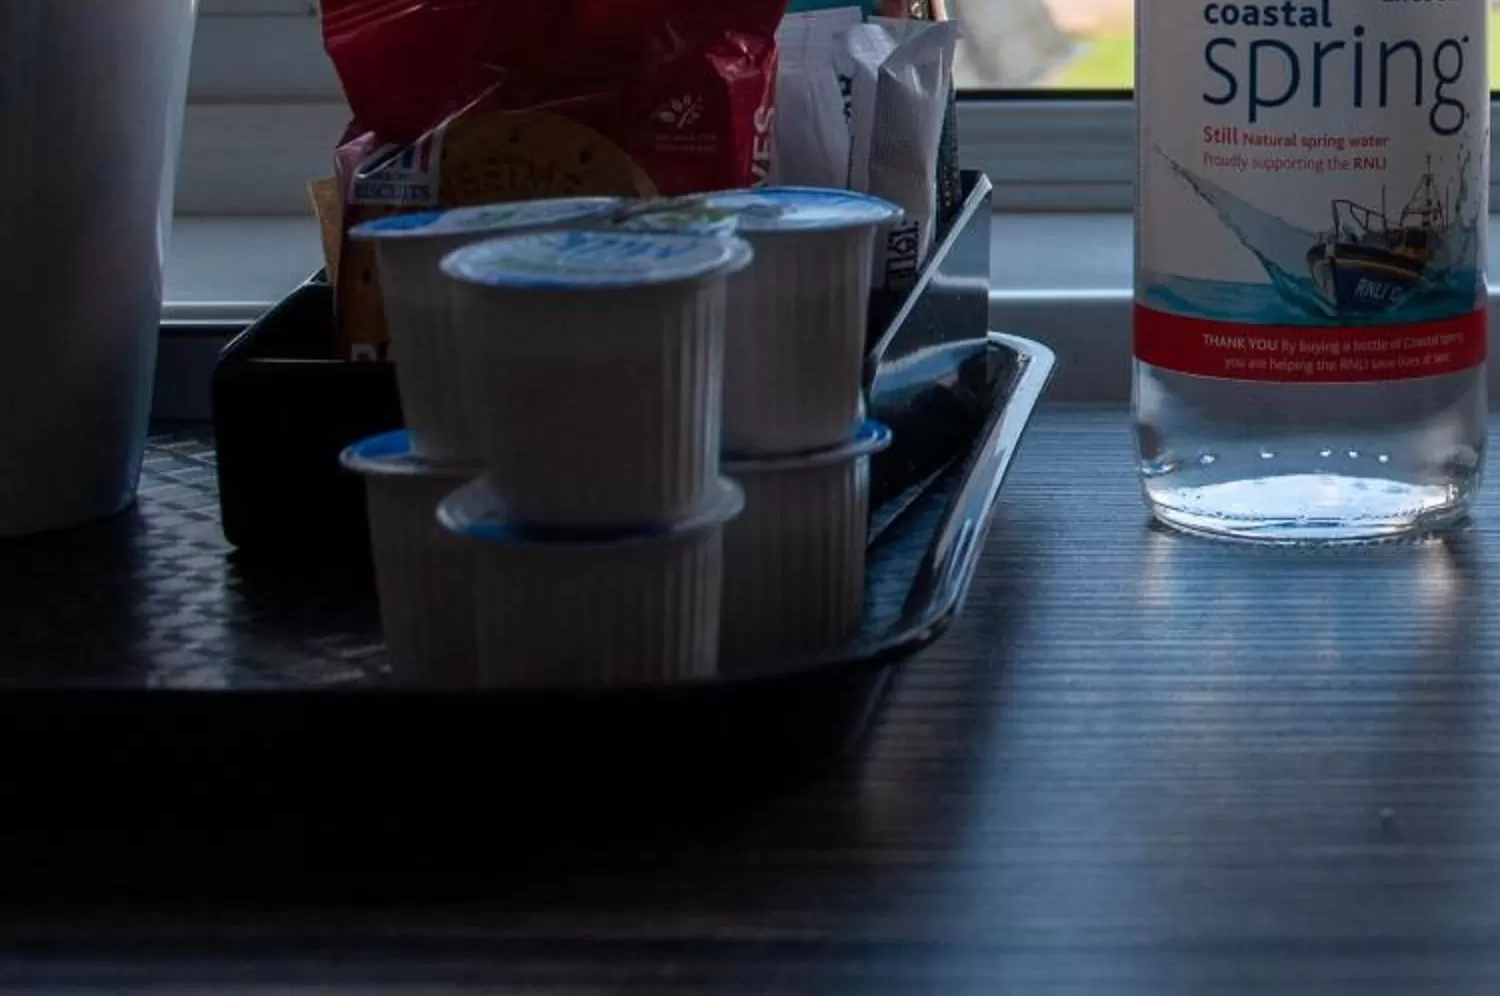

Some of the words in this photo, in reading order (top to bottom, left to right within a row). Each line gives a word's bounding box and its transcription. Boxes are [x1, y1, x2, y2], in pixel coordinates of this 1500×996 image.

[1202, 24, 1467, 136] spring
[1203, 124, 1238, 145] Still
[1243, 131, 1298, 148] Natural
[1301, 132, 1346, 151] spring
[1348, 135, 1390, 149] water
[1252, 155, 1325, 174] supporting
[1353, 156, 1388, 171] RNLI
[1202, 333, 1245, 350] THANK
[1249, 338, 1278, 351] YOU
